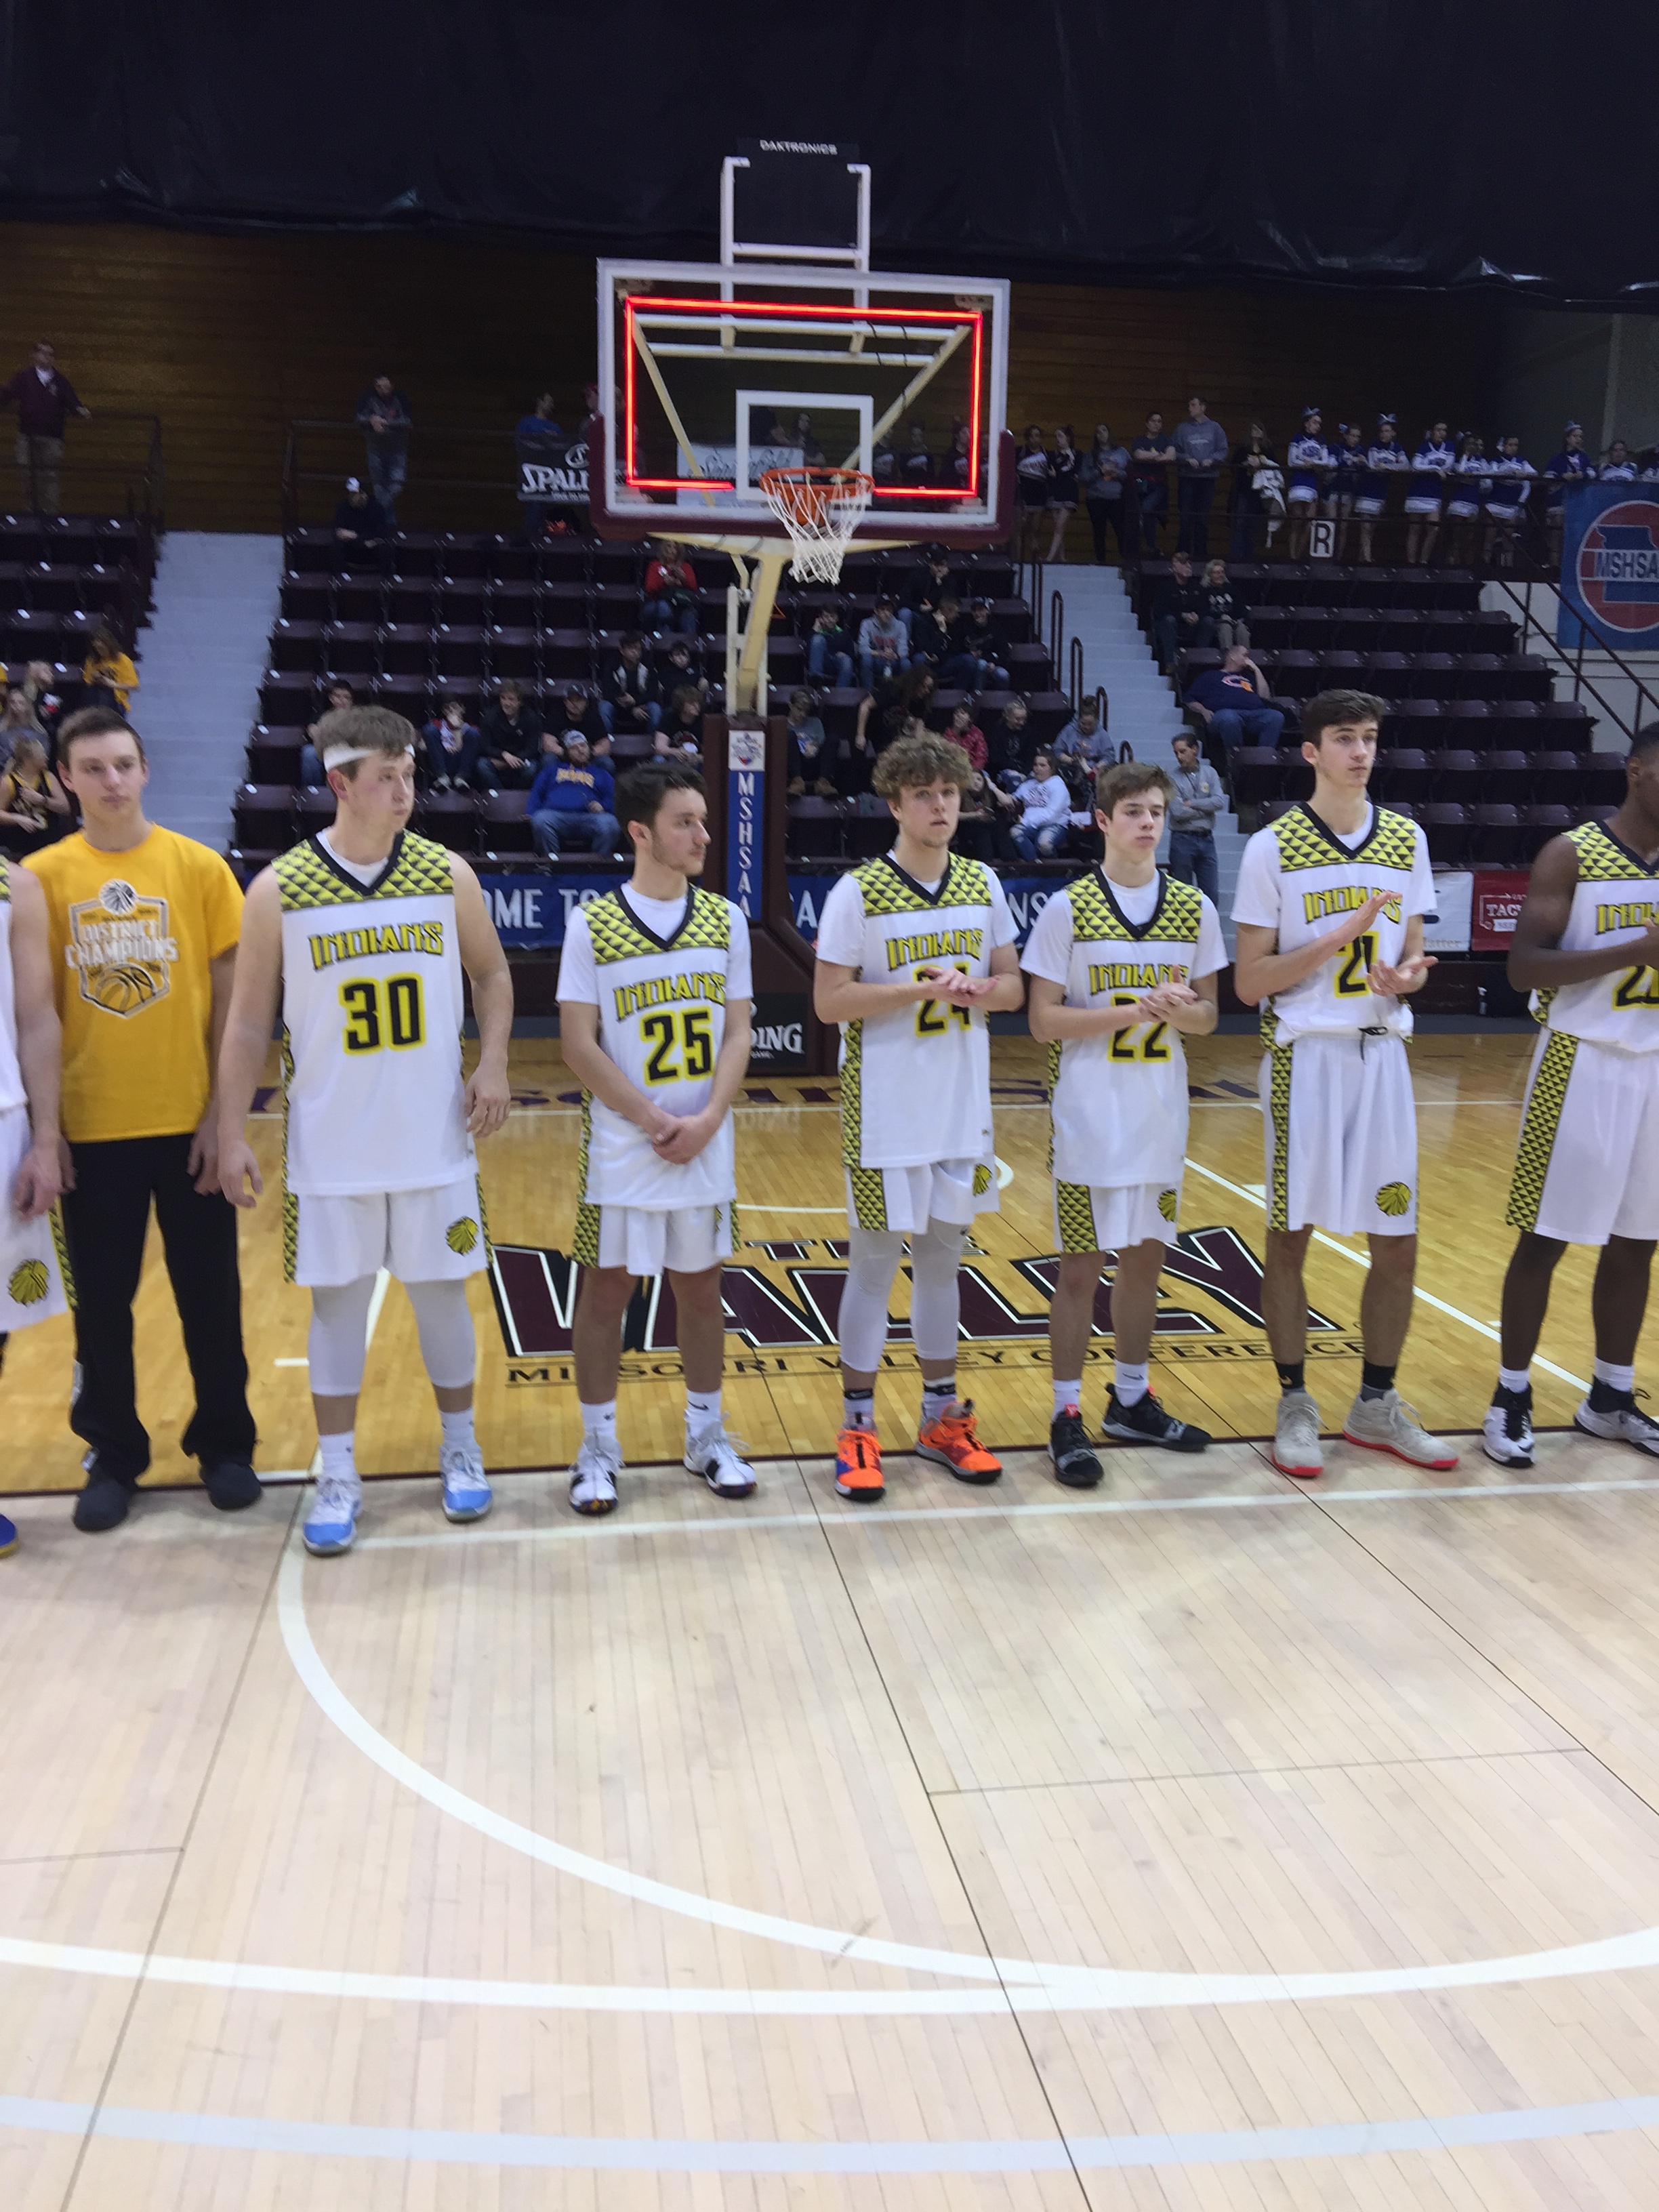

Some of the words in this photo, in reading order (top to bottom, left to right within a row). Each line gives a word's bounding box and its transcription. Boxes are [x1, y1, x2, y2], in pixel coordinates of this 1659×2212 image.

[759, 139, 838, 155] DAKTRONICS
[1595, 902, 1659, 935] INDI
[308, 921, 444, 972] INDIANS
[886, 928, 984, 972] INDIANS
[338, 972, 427, 1056] 30
[613, 970, 726, 1022] INDIANS
[640, 1006, 716, 1087] 25
[508, 1357, 787, 1382] MISORI
[815, 1351, 1004, 1368] VLEY
[1030, 1341, 1365, 1362] CFERECE
